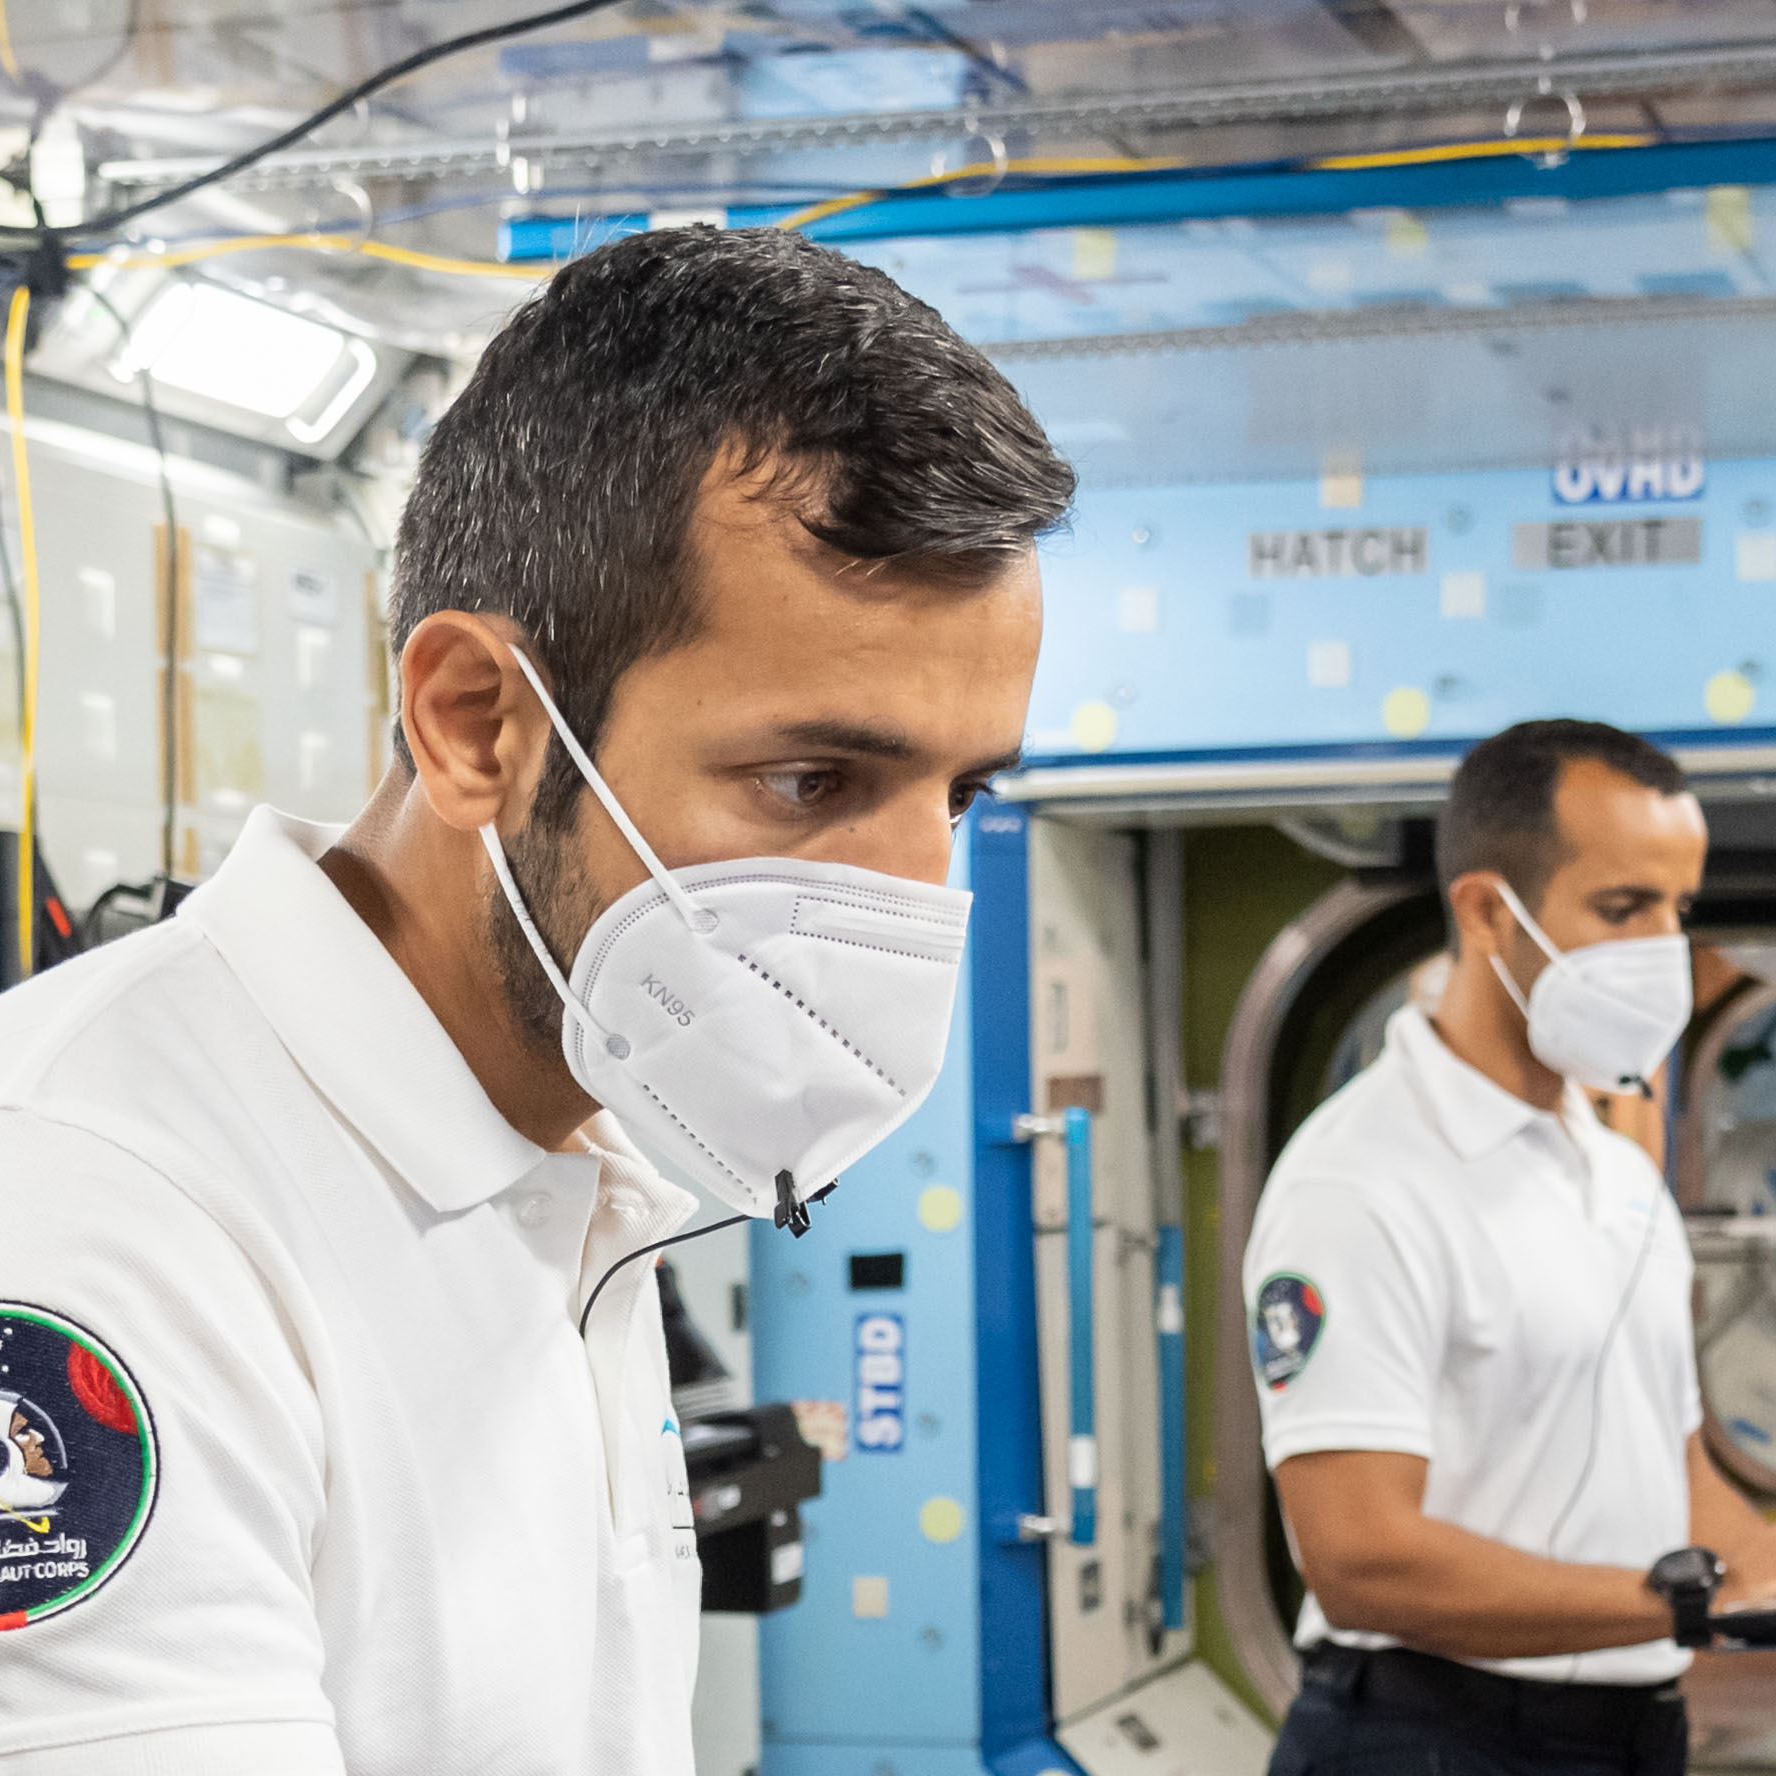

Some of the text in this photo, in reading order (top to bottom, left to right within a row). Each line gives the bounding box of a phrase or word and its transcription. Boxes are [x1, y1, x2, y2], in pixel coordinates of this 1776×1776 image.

[1249, 531, 1424, 576] HATCH
[1548, 521, 1664, 569] EXIT
[640, 973, 696, 1027] KN95
[859, 1317, 902, 1446] STBD
[42, 1532, 88, 1559] رواد
[33, 1561, 91, 1579] CORPS
